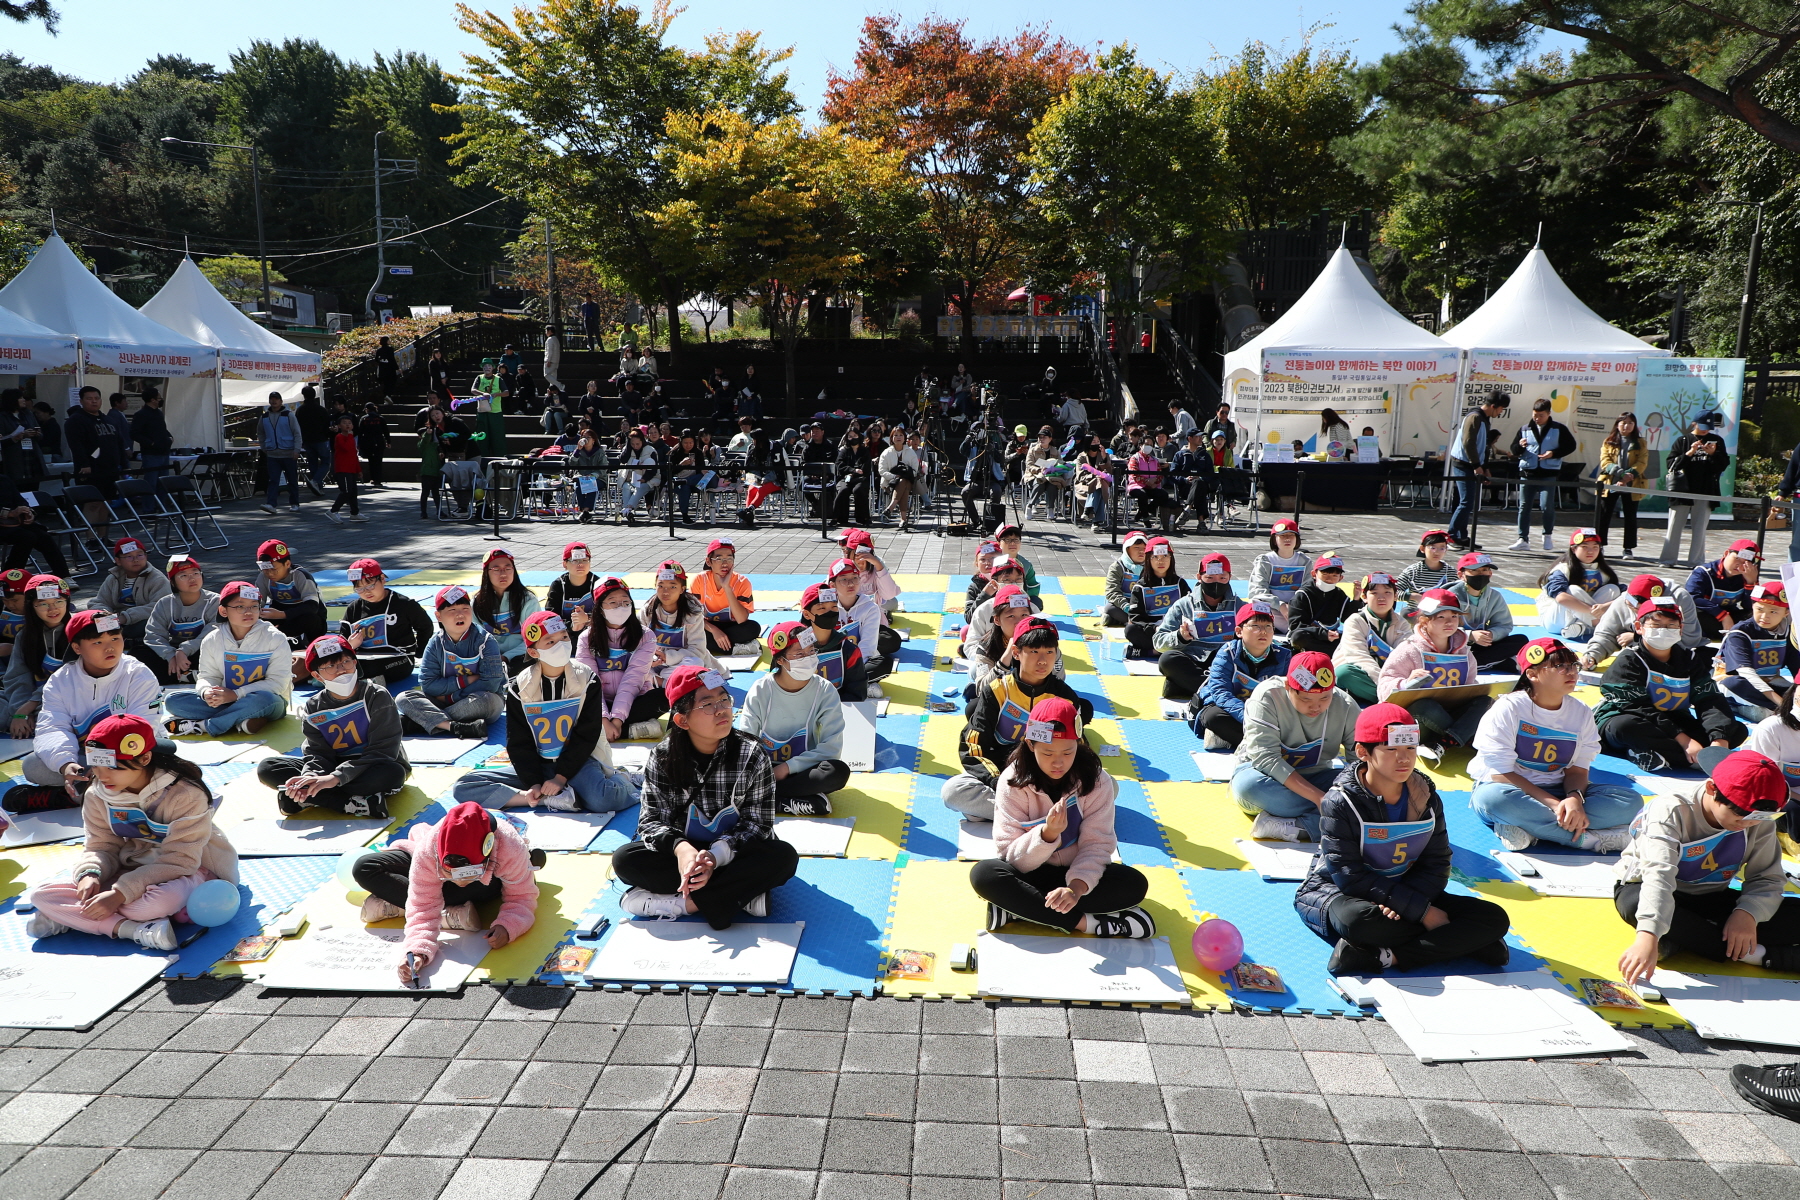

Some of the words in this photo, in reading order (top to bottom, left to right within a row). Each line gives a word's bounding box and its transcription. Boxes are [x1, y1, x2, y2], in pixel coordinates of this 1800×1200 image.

[119, 352, 166, 365] 신나는AR/VR
[168, 356, 192, 366] 세계로!
[1284, 360, 1336, 371] 전통놀이와
[1338, 360, 1378, 372] 함께하는
[1382, 361, 1402, 372] 북한
[1406, 361, 1436, 372] 이야기
[1492, 360, 1544, 371] 전통놀이와
[1546, 360, 1588, 372] 함께하는
[1590, 362, 1612, 372] 북한
[1689, 364, 1717, 372] 통일나무
[1264, 384, 1284, 392] 2023
[1280, 574, 1293, 583] 64
[276, 592, 292, 600] 59
[1154, 595, 1170, 606] 53
[528, 626, 538, 640] 20
[1206, 622, 1222, 634] 41
[774, 636, 784, 648] 19
[1528, 648, 1542, 660] 16
[1757, 650, 1778, 665] 38
[230, 664, 264, 686] 34
[1320, 669, 1330, 683] 17
[1432, 667, 1460, 688] 28
[1654, 688, 1688, 712] 27
[328, 720, 363, 750] 21
[533, 714, 573, 744] 20
[128, 740, 138, 751] 9
[1532, 740, 1557, 762] 16
[771, 744, 792, 762] 19
[1392, 843, 1408, 864] 5
[1701, 850, 1718, 872] 4
